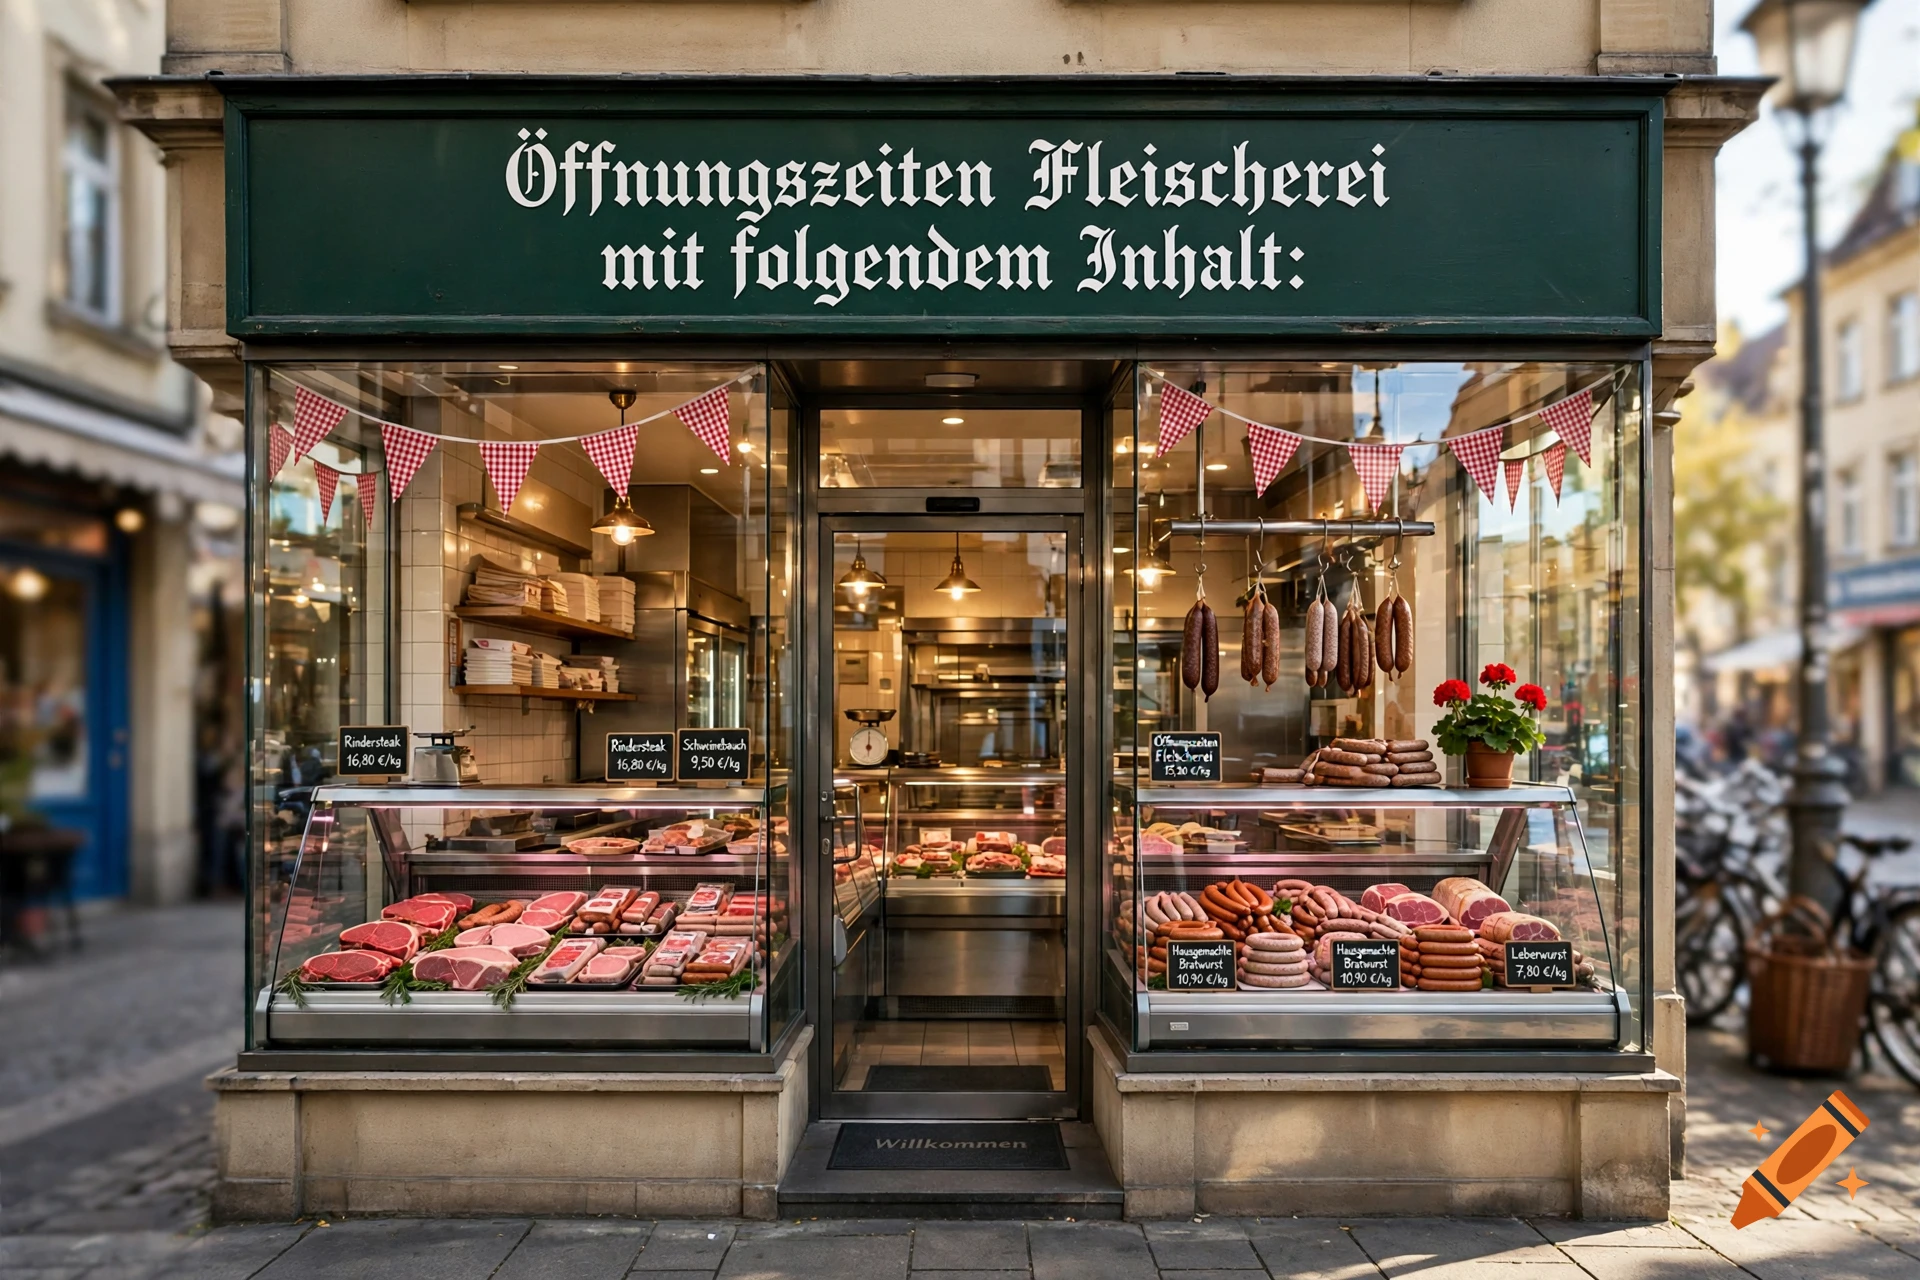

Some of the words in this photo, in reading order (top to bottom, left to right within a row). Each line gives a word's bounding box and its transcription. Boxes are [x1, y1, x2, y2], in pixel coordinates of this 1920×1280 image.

[506, 128, 996, 223] Öffnungszeiten
[1025, 139, 1390, 216] Fleischerei
[601, 228, 705, 291] mit
[731, 225, 1053, 307] folgendem
[1077, 225, 1305, 299] Inhalt:
[344, 734, 401, 748] Rindersteak
[346, 753, 375, 768] 16,80
[377, 753, 402, 769] €/kg
[691, 755, 715, 771] 9,50
[717, 756, 740, 772] €/kg
[1511, 947, 1568, 960] Leberwurst
[1179, 957, 1224, 970] Bratwurst
[1340, 971, 1367, 986] 10,90
[1515, 964, 1540, 980] 7,80
[1543, 964, 1567, 981] €/kg
[1177, 973, 1204, 987] 10,90
[1206, 973, 1229, 988] €/kg
[874, 1138, 1028, 1150] Willkommen
